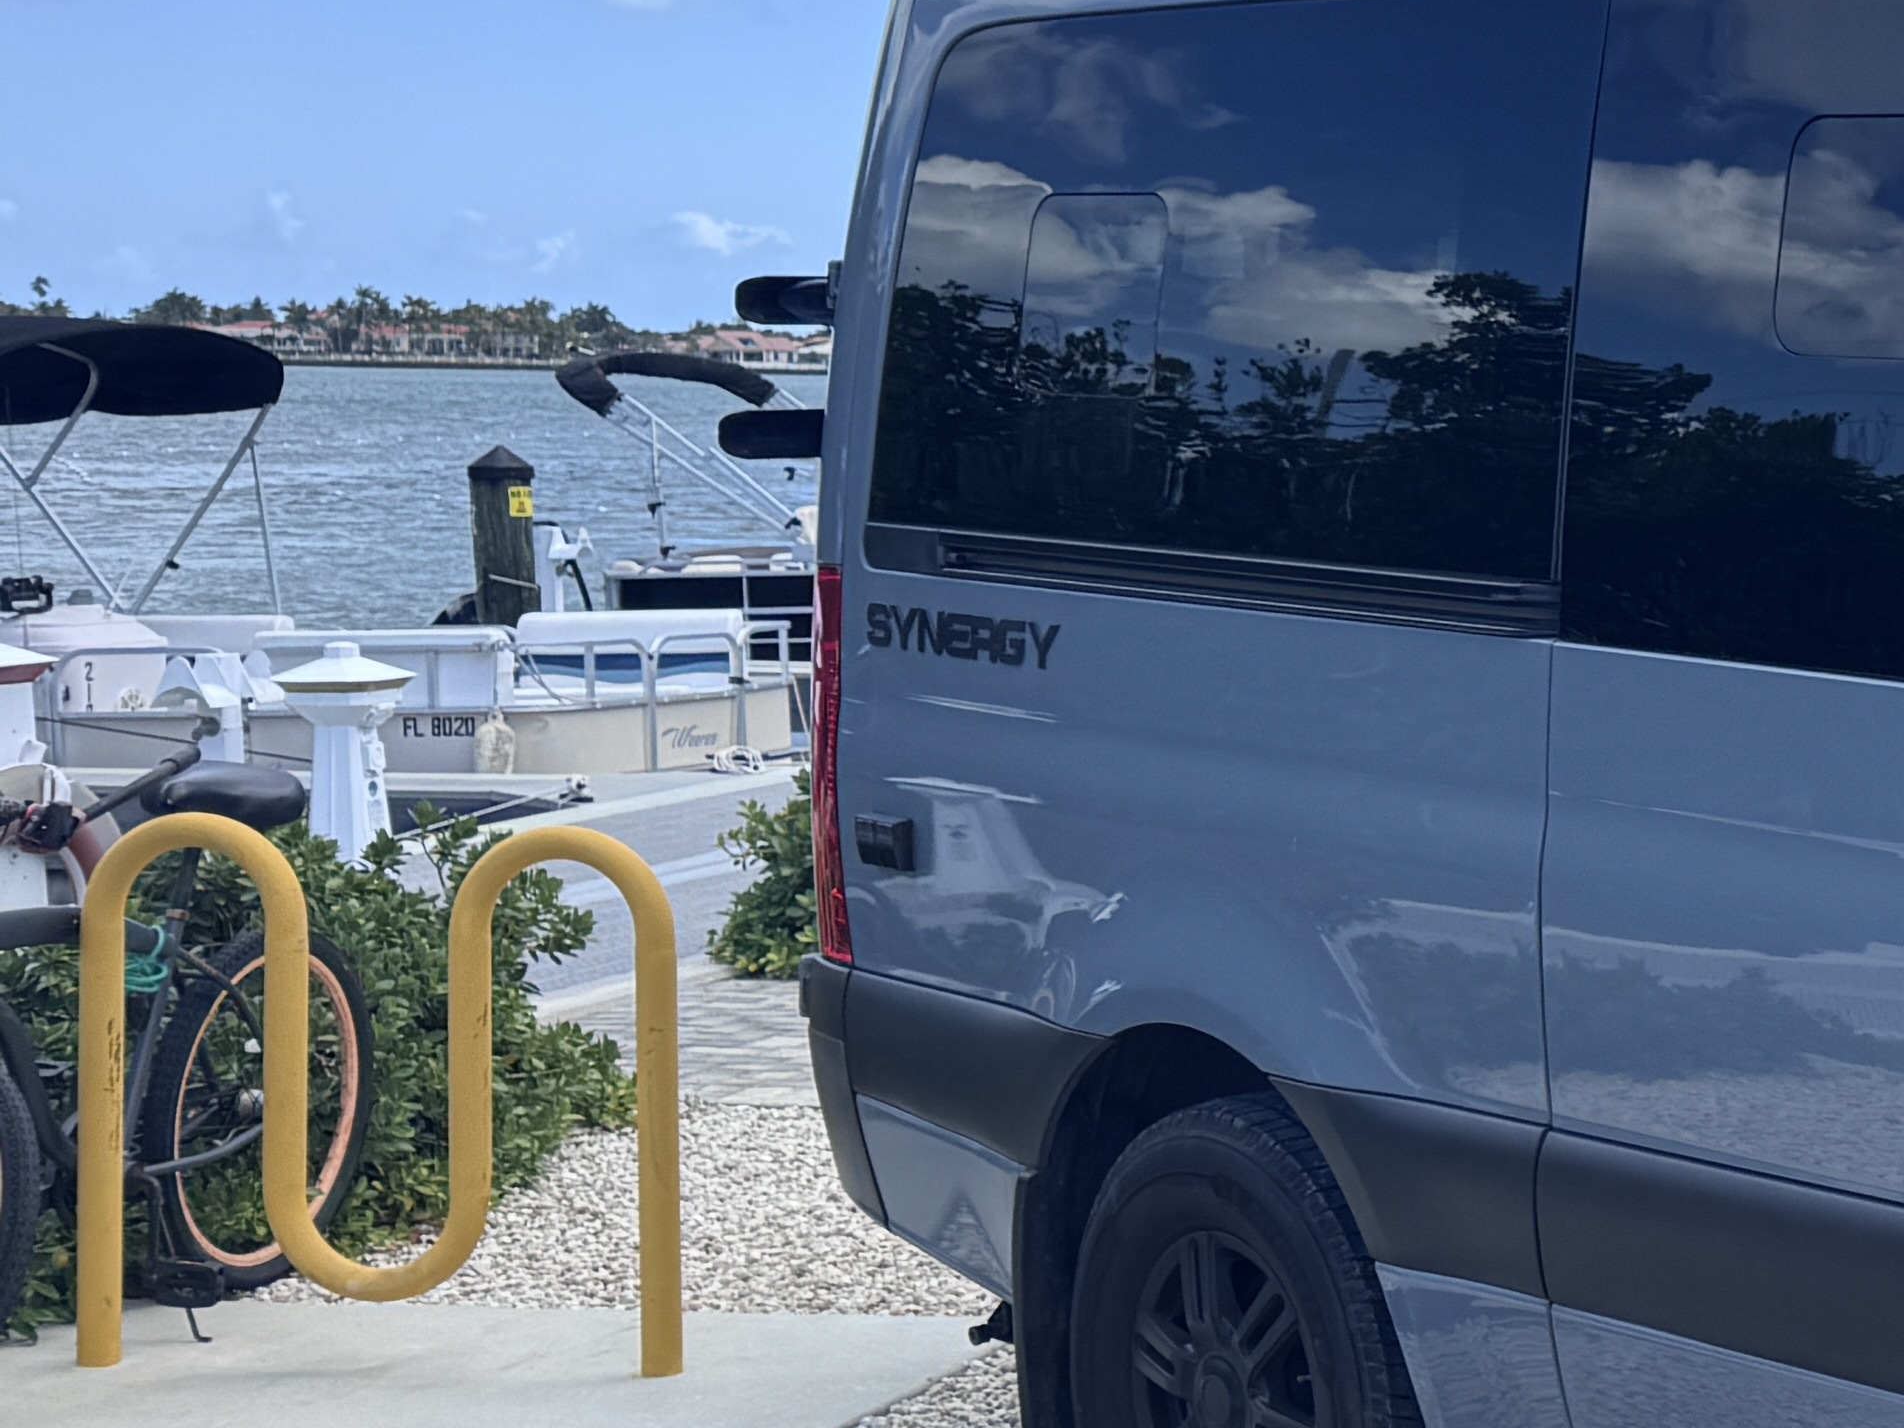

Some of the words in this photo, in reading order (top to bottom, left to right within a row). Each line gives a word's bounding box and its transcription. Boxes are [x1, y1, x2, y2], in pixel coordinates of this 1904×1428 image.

[867, 603, 1061, 670] SYNERGY
[402, 716, 424, 738] FL
[431, 716, 475, 738] 8020
